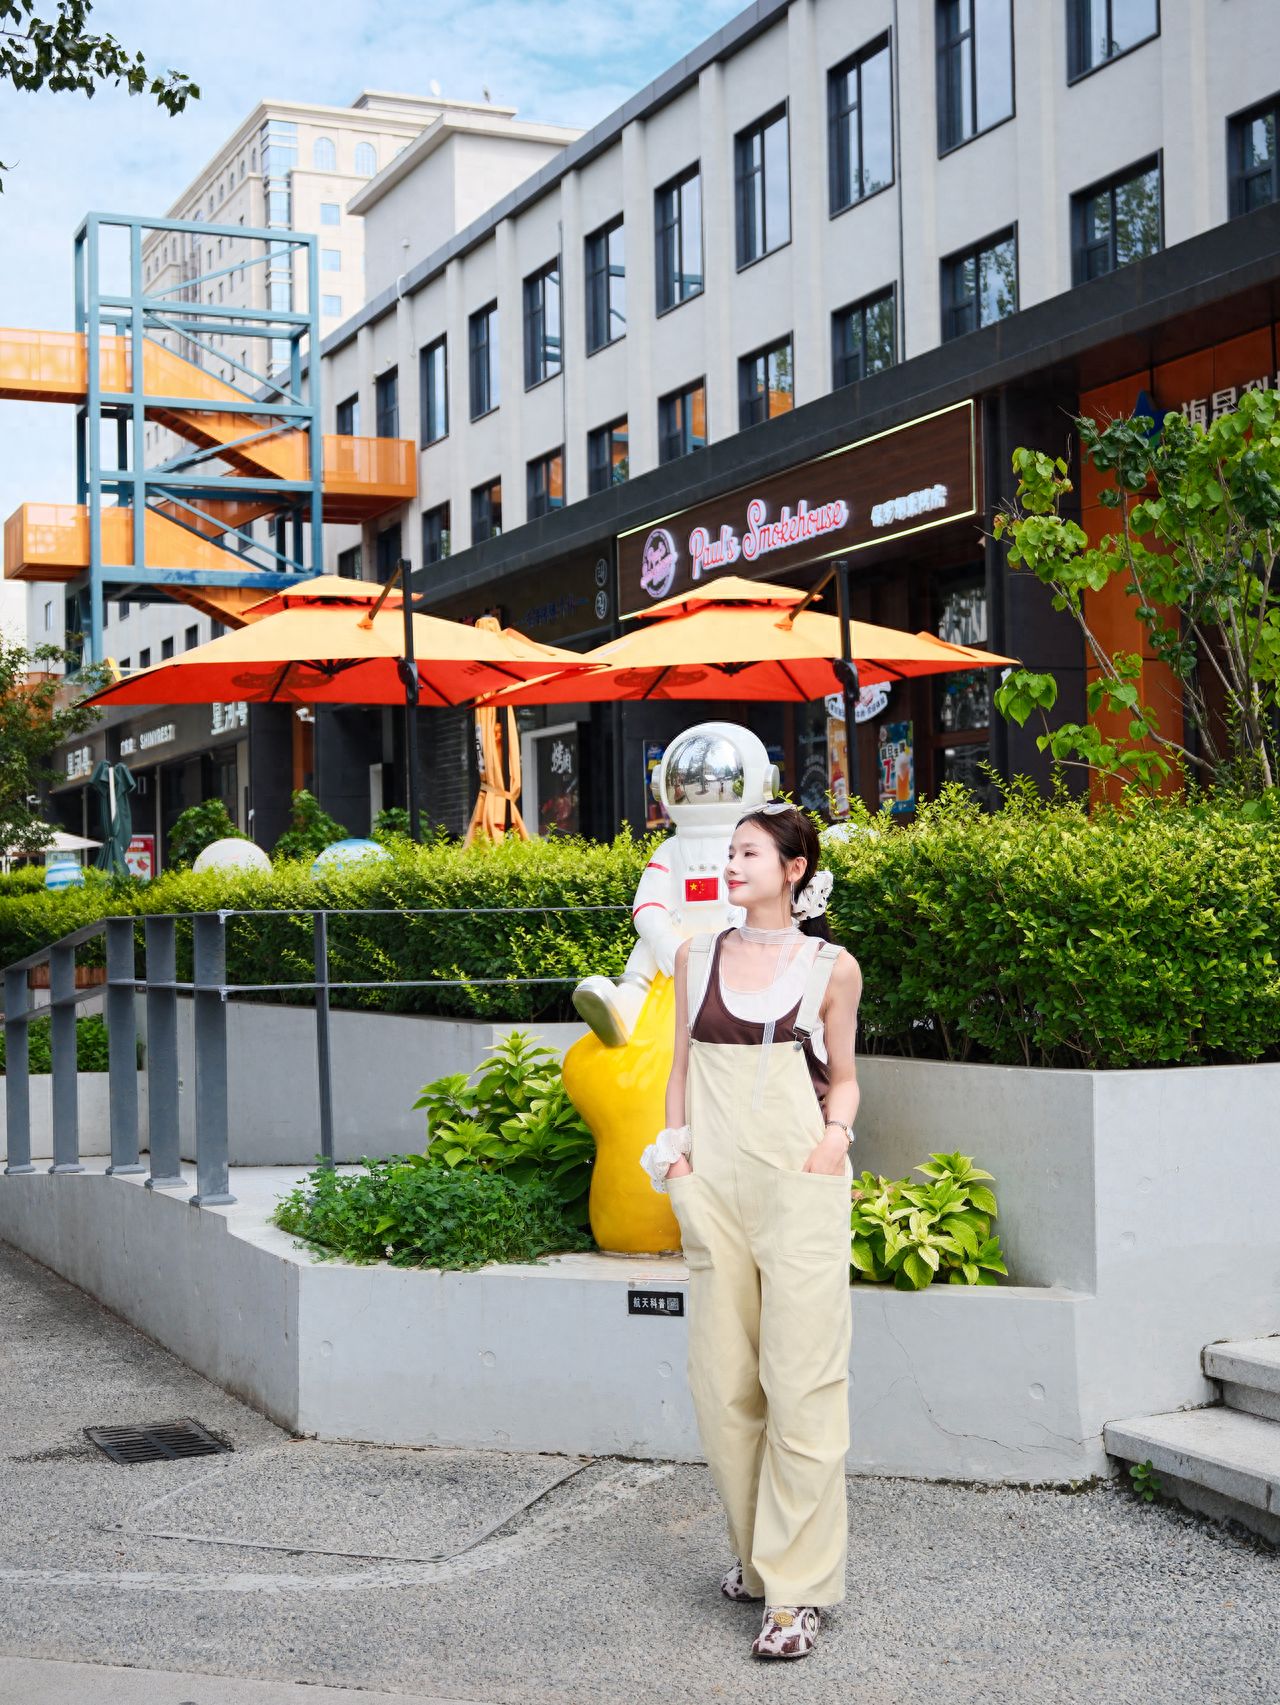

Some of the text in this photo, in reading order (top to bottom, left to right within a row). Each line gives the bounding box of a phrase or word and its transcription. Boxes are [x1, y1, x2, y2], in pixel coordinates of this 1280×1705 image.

[689, 527, 741, 580] Paul's
[742, 499, 849, 561] Smokehouse
[633, 1296, 666, 1310] 航天科普
